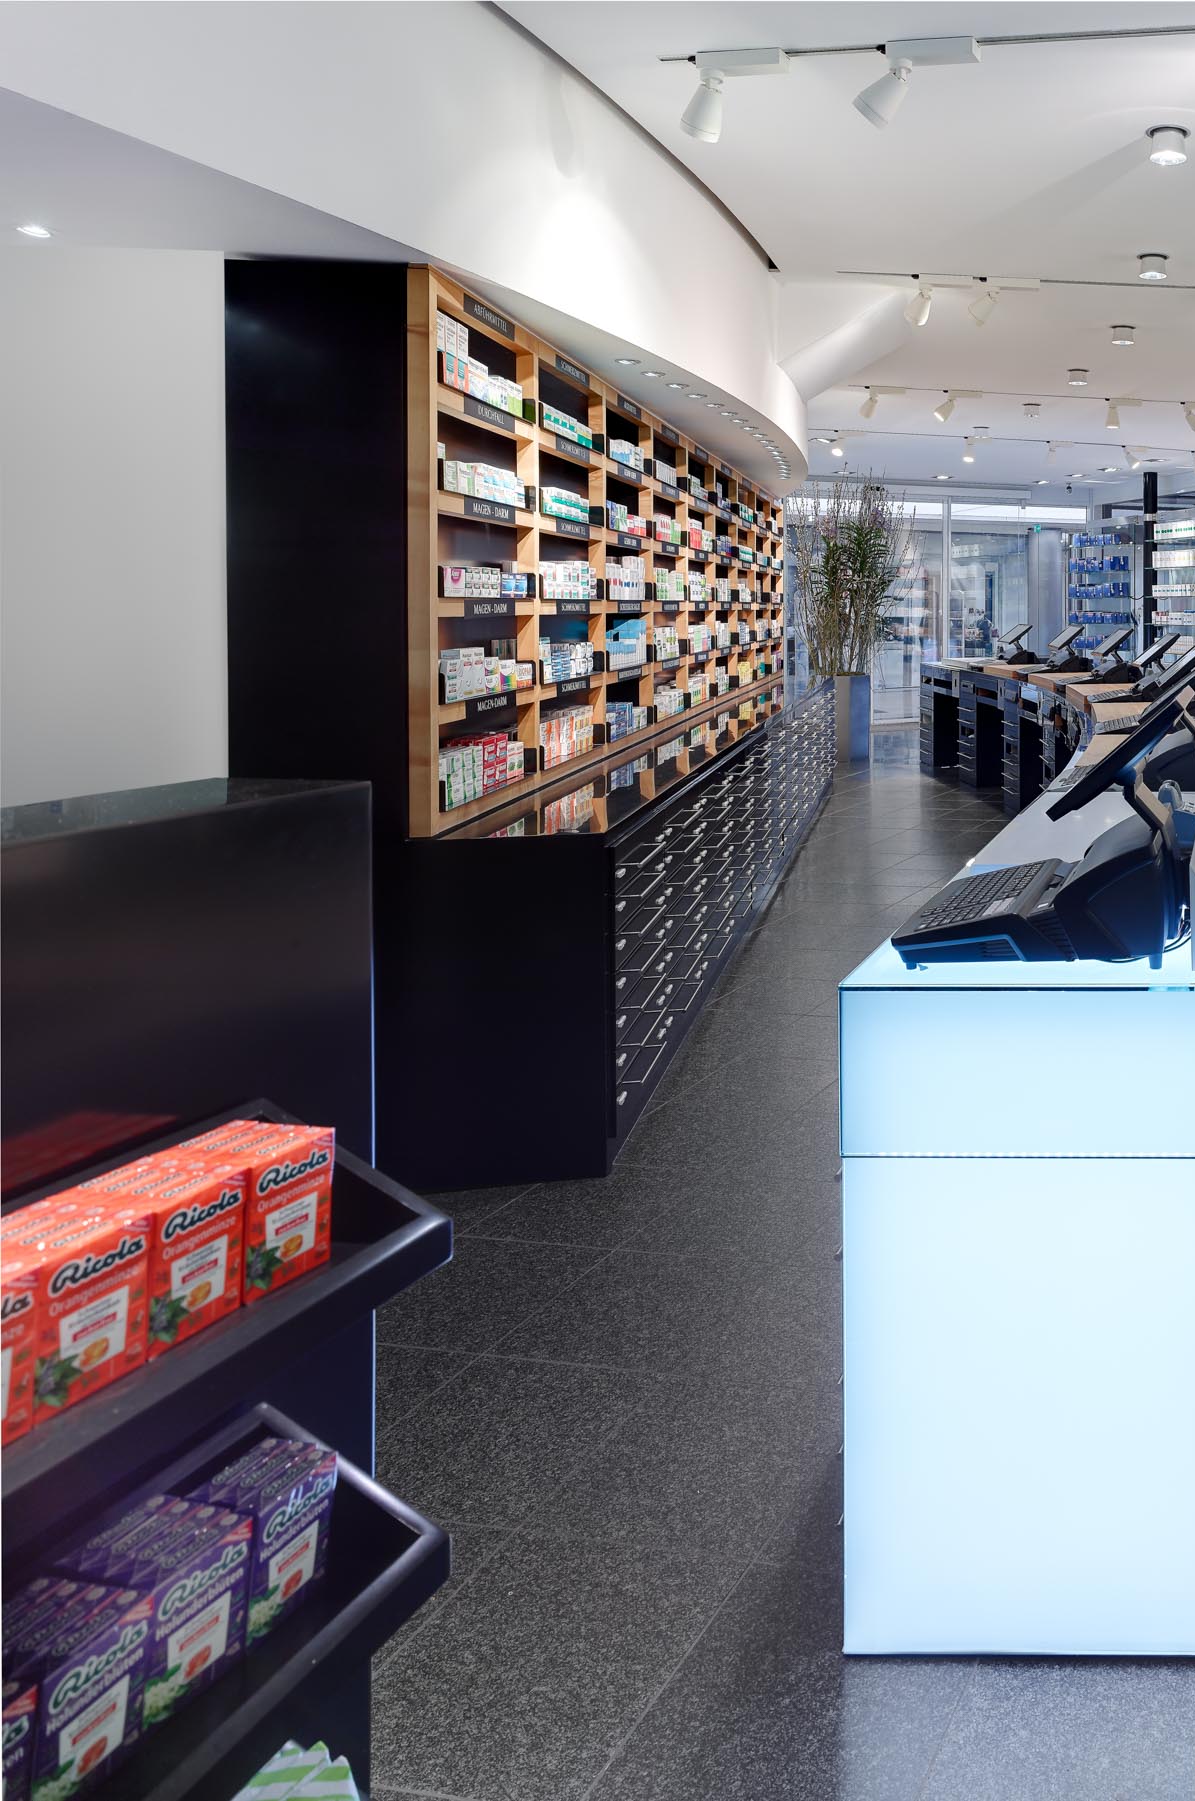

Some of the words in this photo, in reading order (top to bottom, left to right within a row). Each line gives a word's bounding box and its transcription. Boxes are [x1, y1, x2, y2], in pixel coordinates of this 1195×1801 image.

[473, 503, 492, 516] MAGEN
[495, 507, 509, 519] DARM
[473, 603, 492, 615] MAGEN
[494, 603, 508, 614] DARM
[256, 1148, 331, 1196] Ricola
[161, 1187, 242, 1243] Ricola
[162, 1215, 236, 1260] Orangenminze
[47, 1233, 145, 1298] Ricola
[262, 1473, 333, 1543] Ricola
[155, 1567, 244, 1642] Holunderblüten
[158, 1540, 248, 1621] Ricola
[46, 1647, 144, 1736] Holunderblüten
[48, 1619, 148, 1715] Ricola
